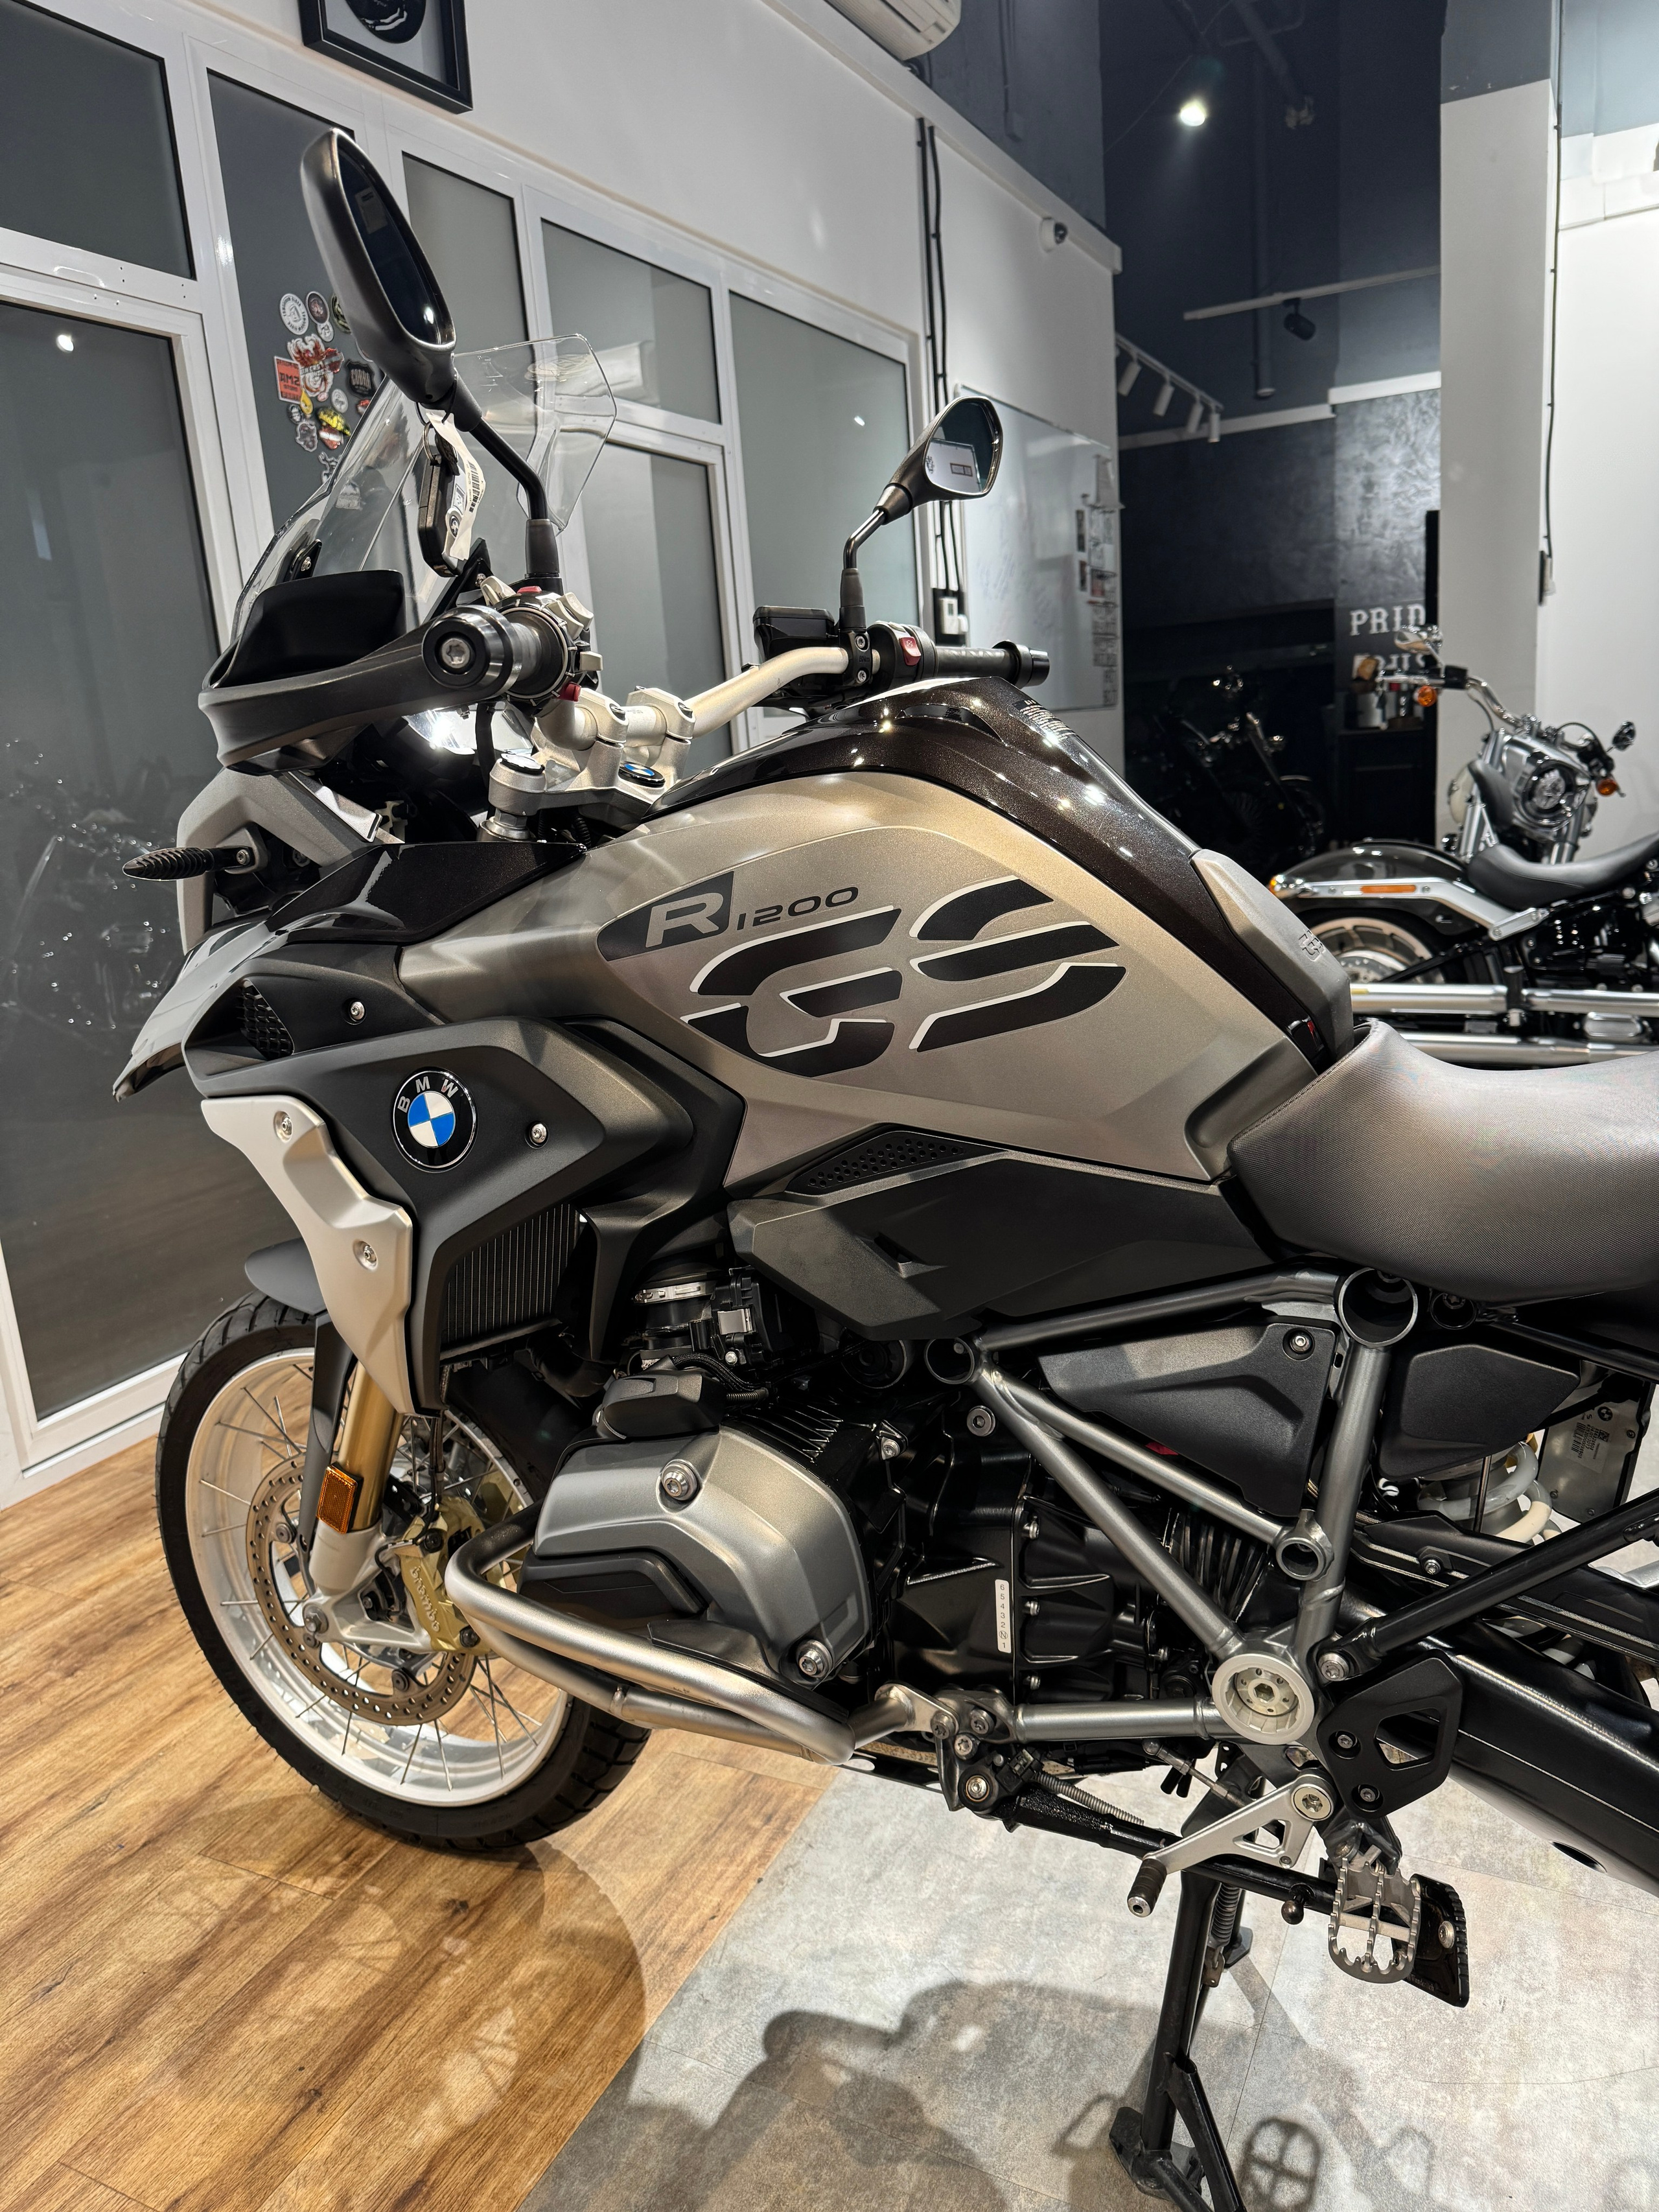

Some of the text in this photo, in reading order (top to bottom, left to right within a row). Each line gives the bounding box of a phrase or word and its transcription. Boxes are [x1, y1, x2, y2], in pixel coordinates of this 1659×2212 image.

[737, 887, 859, 931] 1200
[680, 875, 1126, 1078] GS
[397, 1076, 459, 1113] BMW
[410, 1565, 441, 1633] brembo
